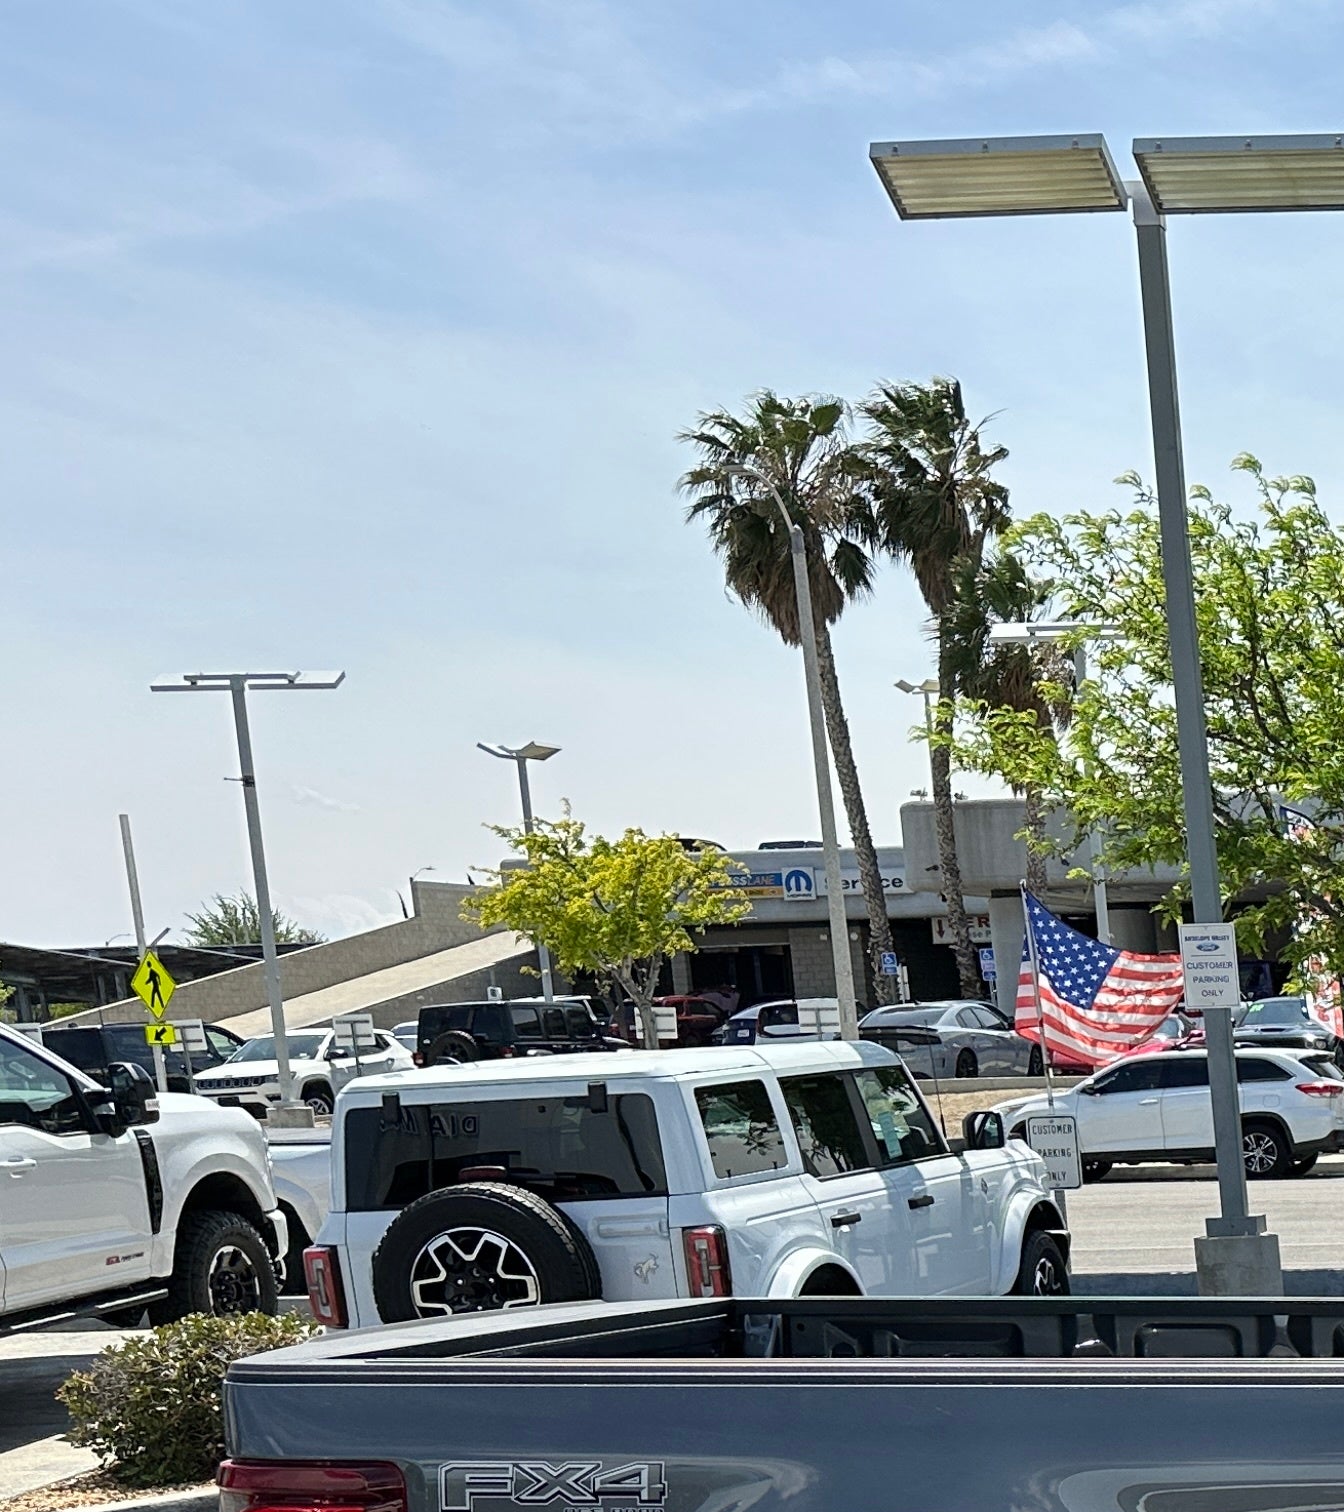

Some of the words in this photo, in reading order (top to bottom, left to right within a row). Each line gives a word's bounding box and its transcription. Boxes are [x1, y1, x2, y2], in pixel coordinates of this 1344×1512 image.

[1186, 961, 1233, 970] CUSTOMER
[1193, 975, 1230, 984] PARKING
[1201, 989, 1224, 997] ONLY
[1032, 1124, 1073, 1135] CUSTOMER
[1038, 1148, 1072, 1158] PARKING
